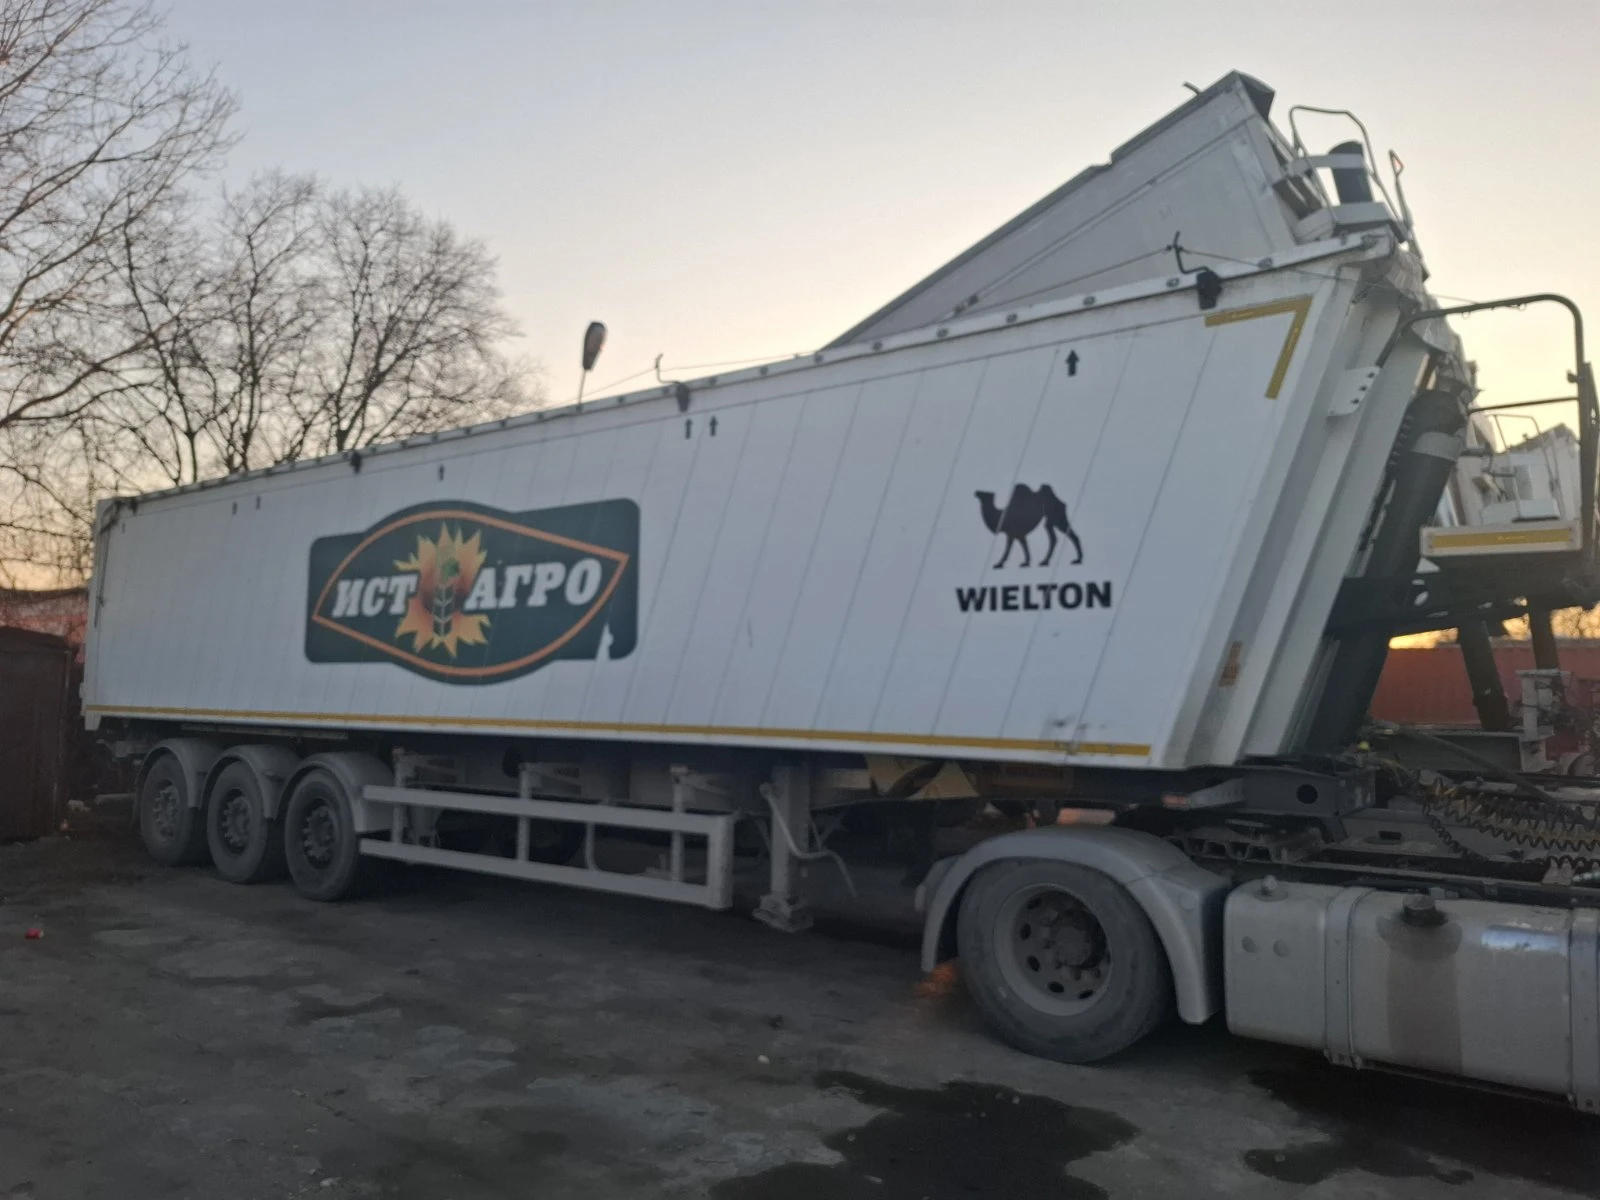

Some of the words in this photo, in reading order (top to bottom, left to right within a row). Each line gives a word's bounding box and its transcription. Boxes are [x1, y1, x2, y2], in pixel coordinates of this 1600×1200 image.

[332, 574, 418, 618] ИСТ
[464, 558, 602, 611] АГРО
[956, 581, 1112, 612] WIELTON
